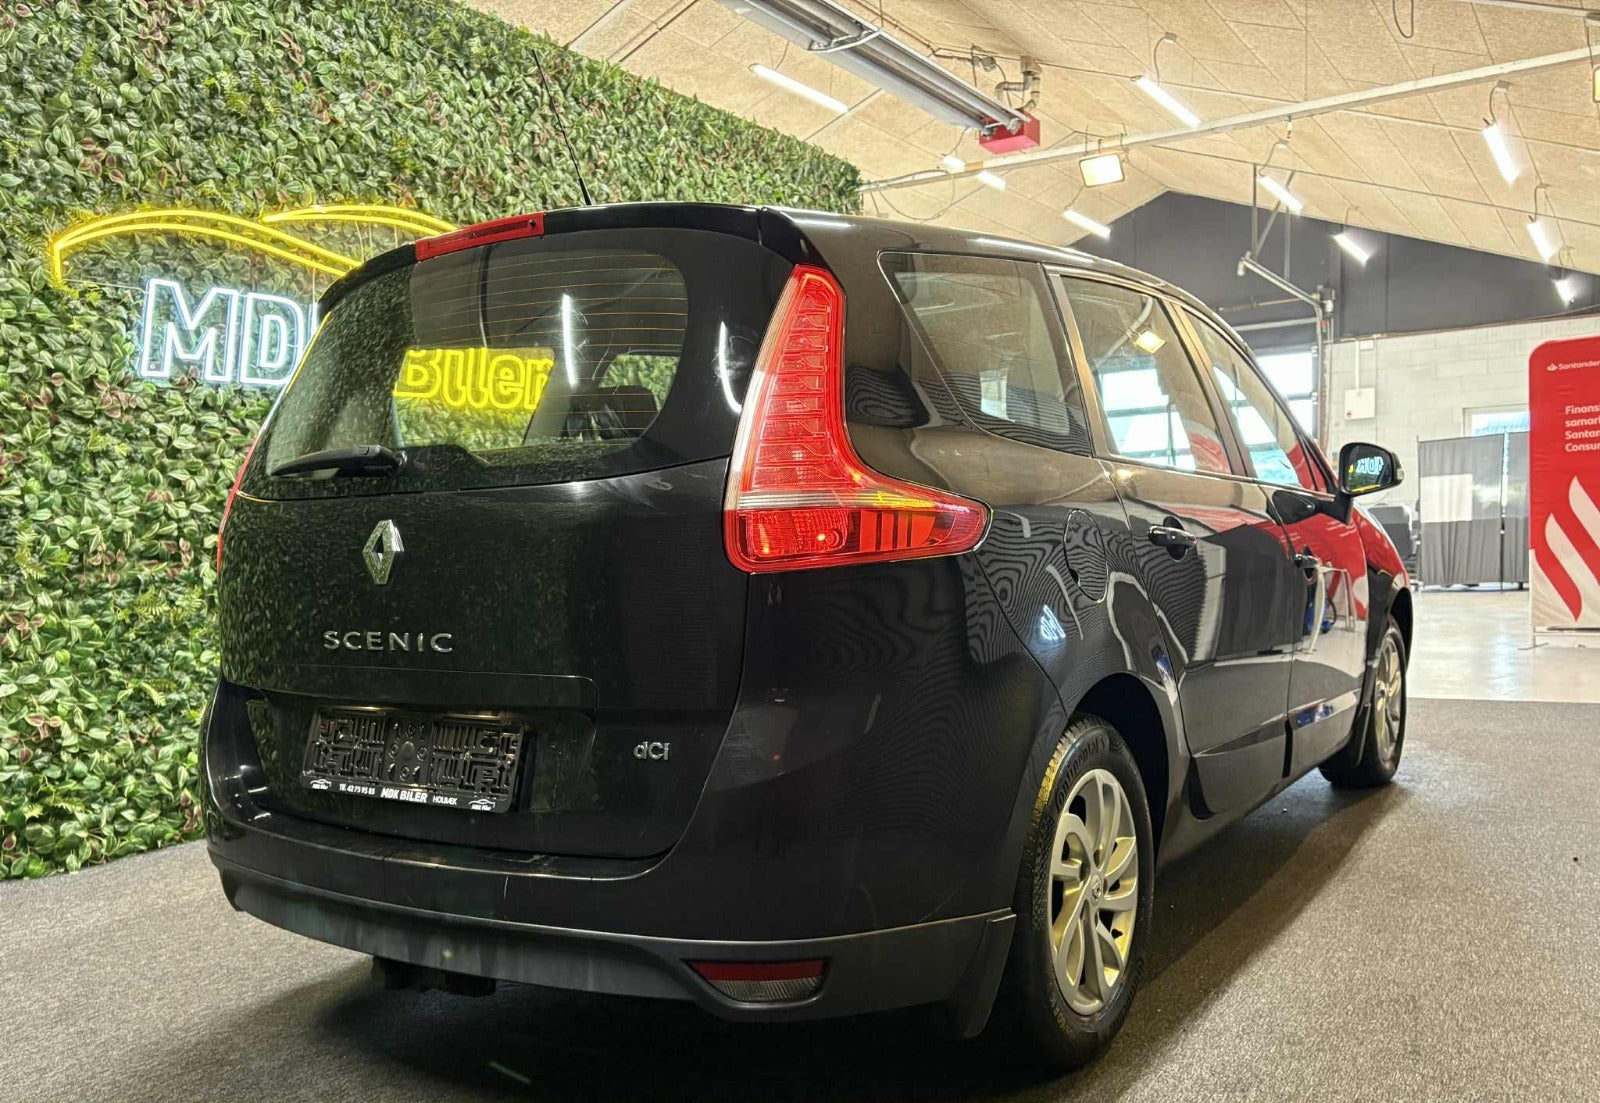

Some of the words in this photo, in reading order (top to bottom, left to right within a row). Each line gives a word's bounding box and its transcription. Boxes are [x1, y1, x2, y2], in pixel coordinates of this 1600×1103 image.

[139, 277, 320, 385] MD
[1565, 403, 1600, 415] Finans
[1565, 415, 1600, 428] samar
[323, 630, 453, 653] SCENIC
[633, 741, 670, 760] dCi
[380, 787, 399, 799] MDK
[399, 790, 428, 803] BILER
